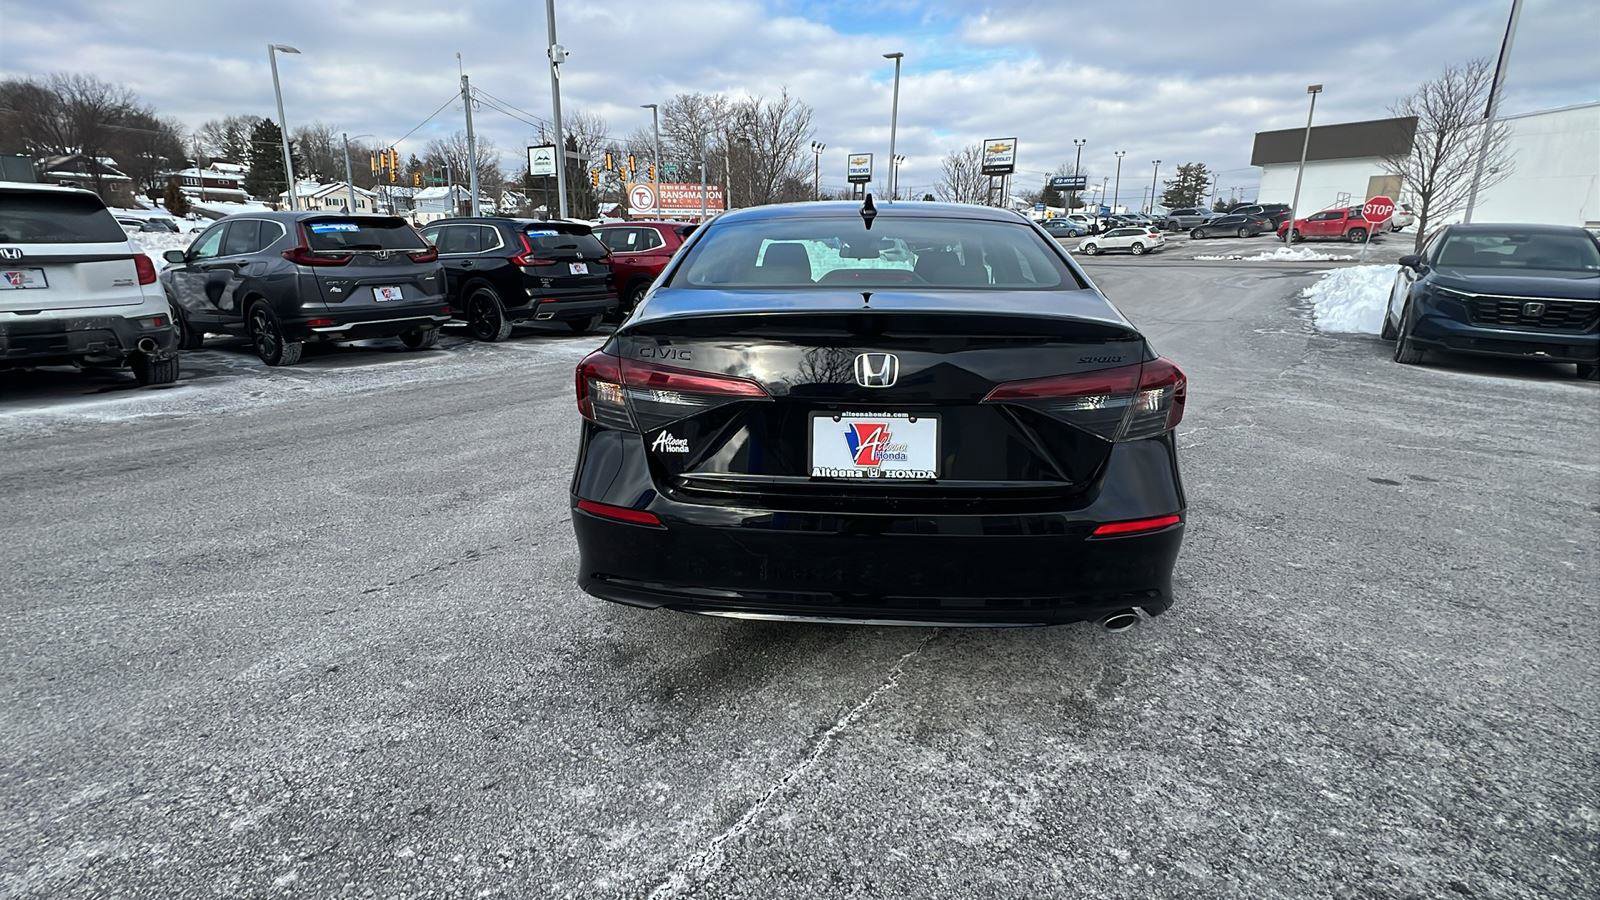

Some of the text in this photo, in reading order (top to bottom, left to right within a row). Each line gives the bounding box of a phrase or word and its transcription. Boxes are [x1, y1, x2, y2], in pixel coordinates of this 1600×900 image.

[1364, 204, 1393, 216] STOP
[640, 347, 692, 361] CIVIC
[1076, 354, 1127, 364] SPORT
[652, 429, 688, 453] Altoona
[666, 445, 690, 453] Honda
[876, 451, 907, 461] Honda
[811, 466, 863, 478] Altoona
[885, 469, 938, 479] HONDA
